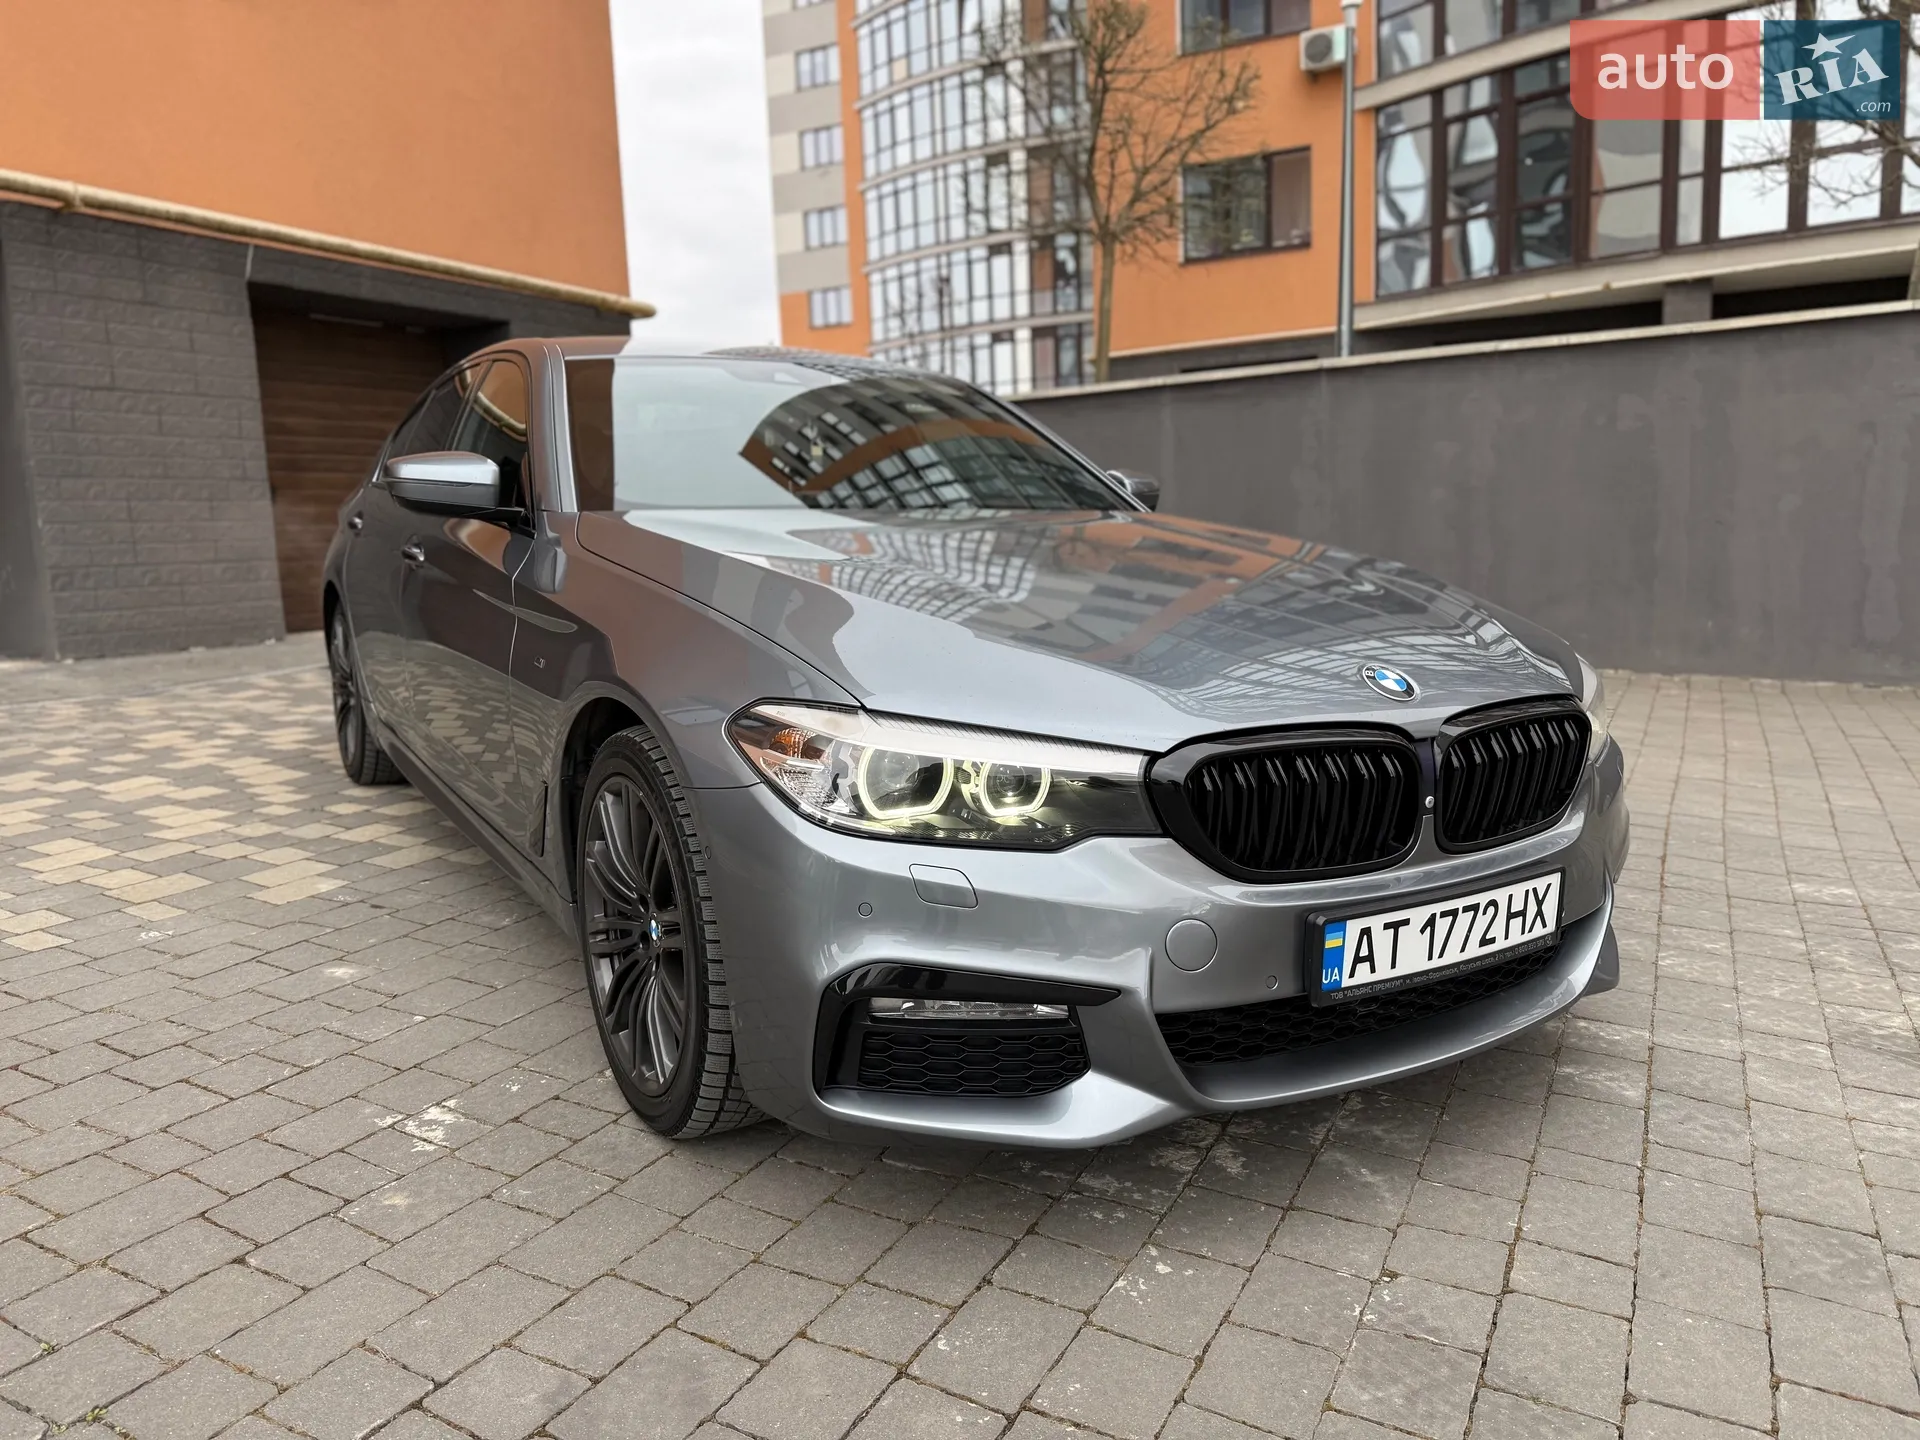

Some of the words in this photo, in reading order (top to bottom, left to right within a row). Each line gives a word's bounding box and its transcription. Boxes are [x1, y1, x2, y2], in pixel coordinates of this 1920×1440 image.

[1348, 917, 1410, 979] AT
[1419, 898, 1499, 962] 1772
[1504, 882, 1552, 941] HX
[1322, 966, 1340, 984] UA
